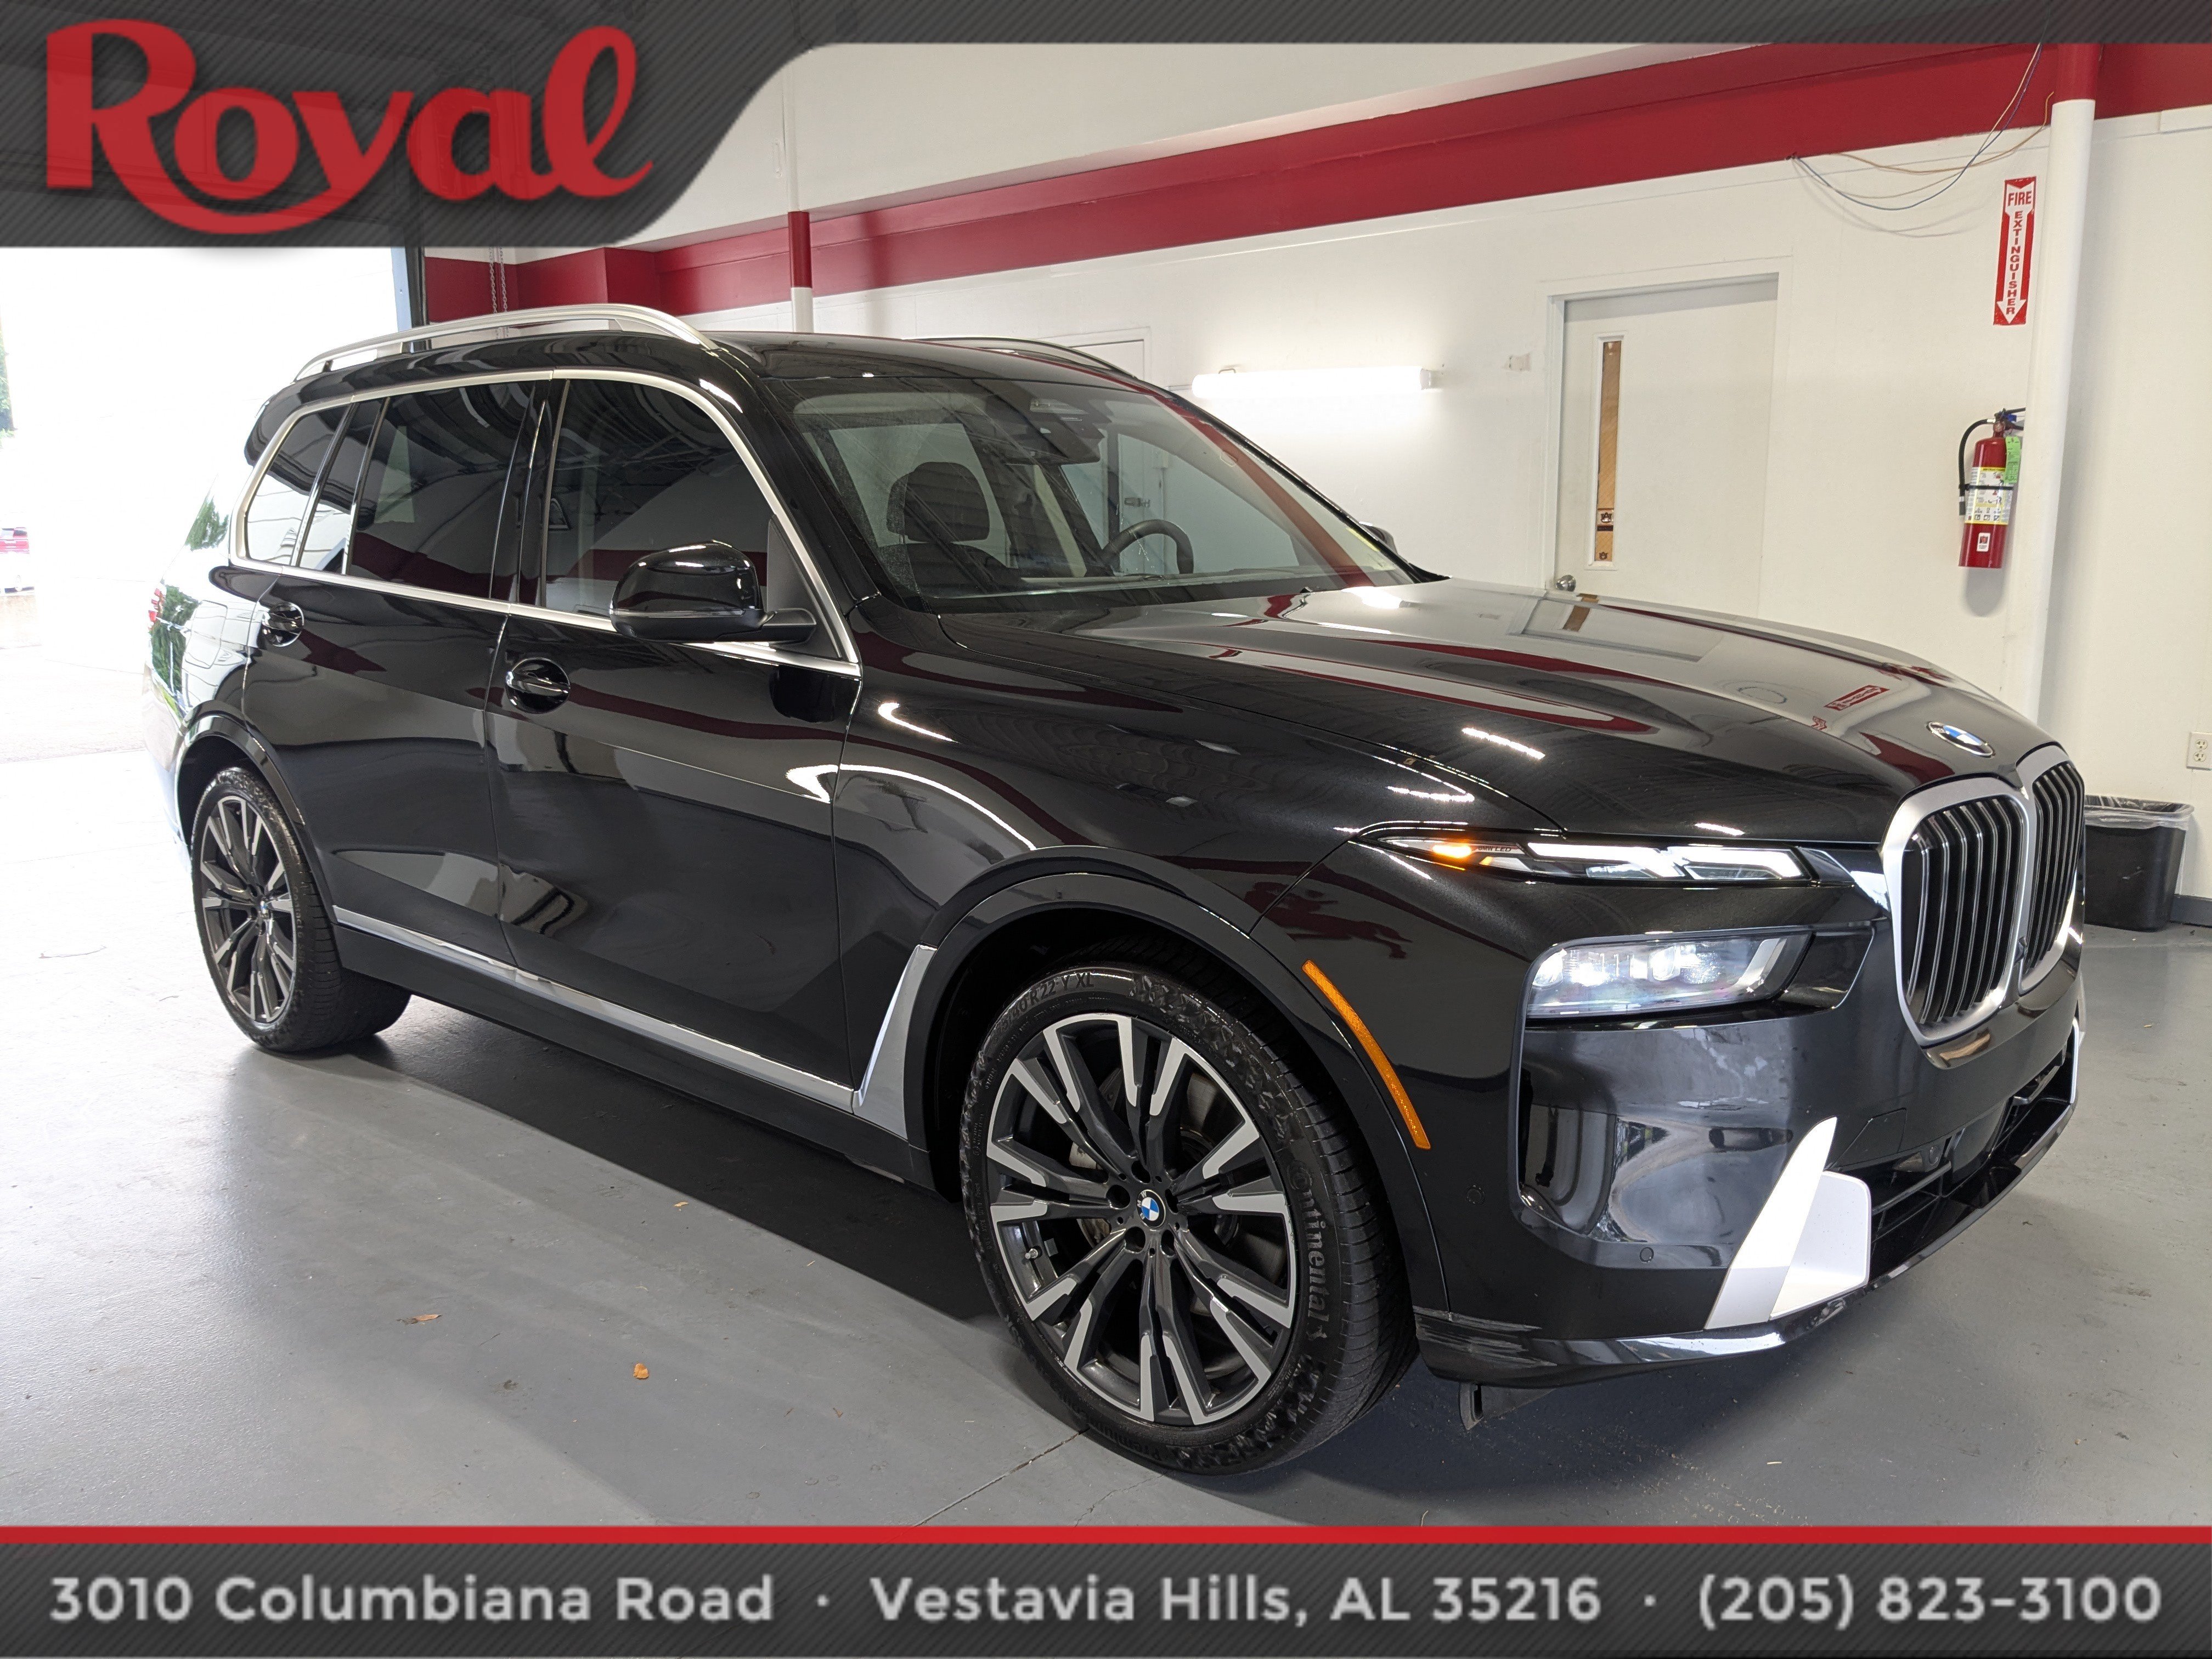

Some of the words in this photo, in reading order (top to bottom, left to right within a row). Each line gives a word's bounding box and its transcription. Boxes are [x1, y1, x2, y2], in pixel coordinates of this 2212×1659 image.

[2007, 191, 2032, 207] FIRE
[2006, 211, 2023, 315] EXTINGUISHER
[1137, 1190, 1147, 1220] BMW
[1288, 1159, 1329, 1322] Continental
